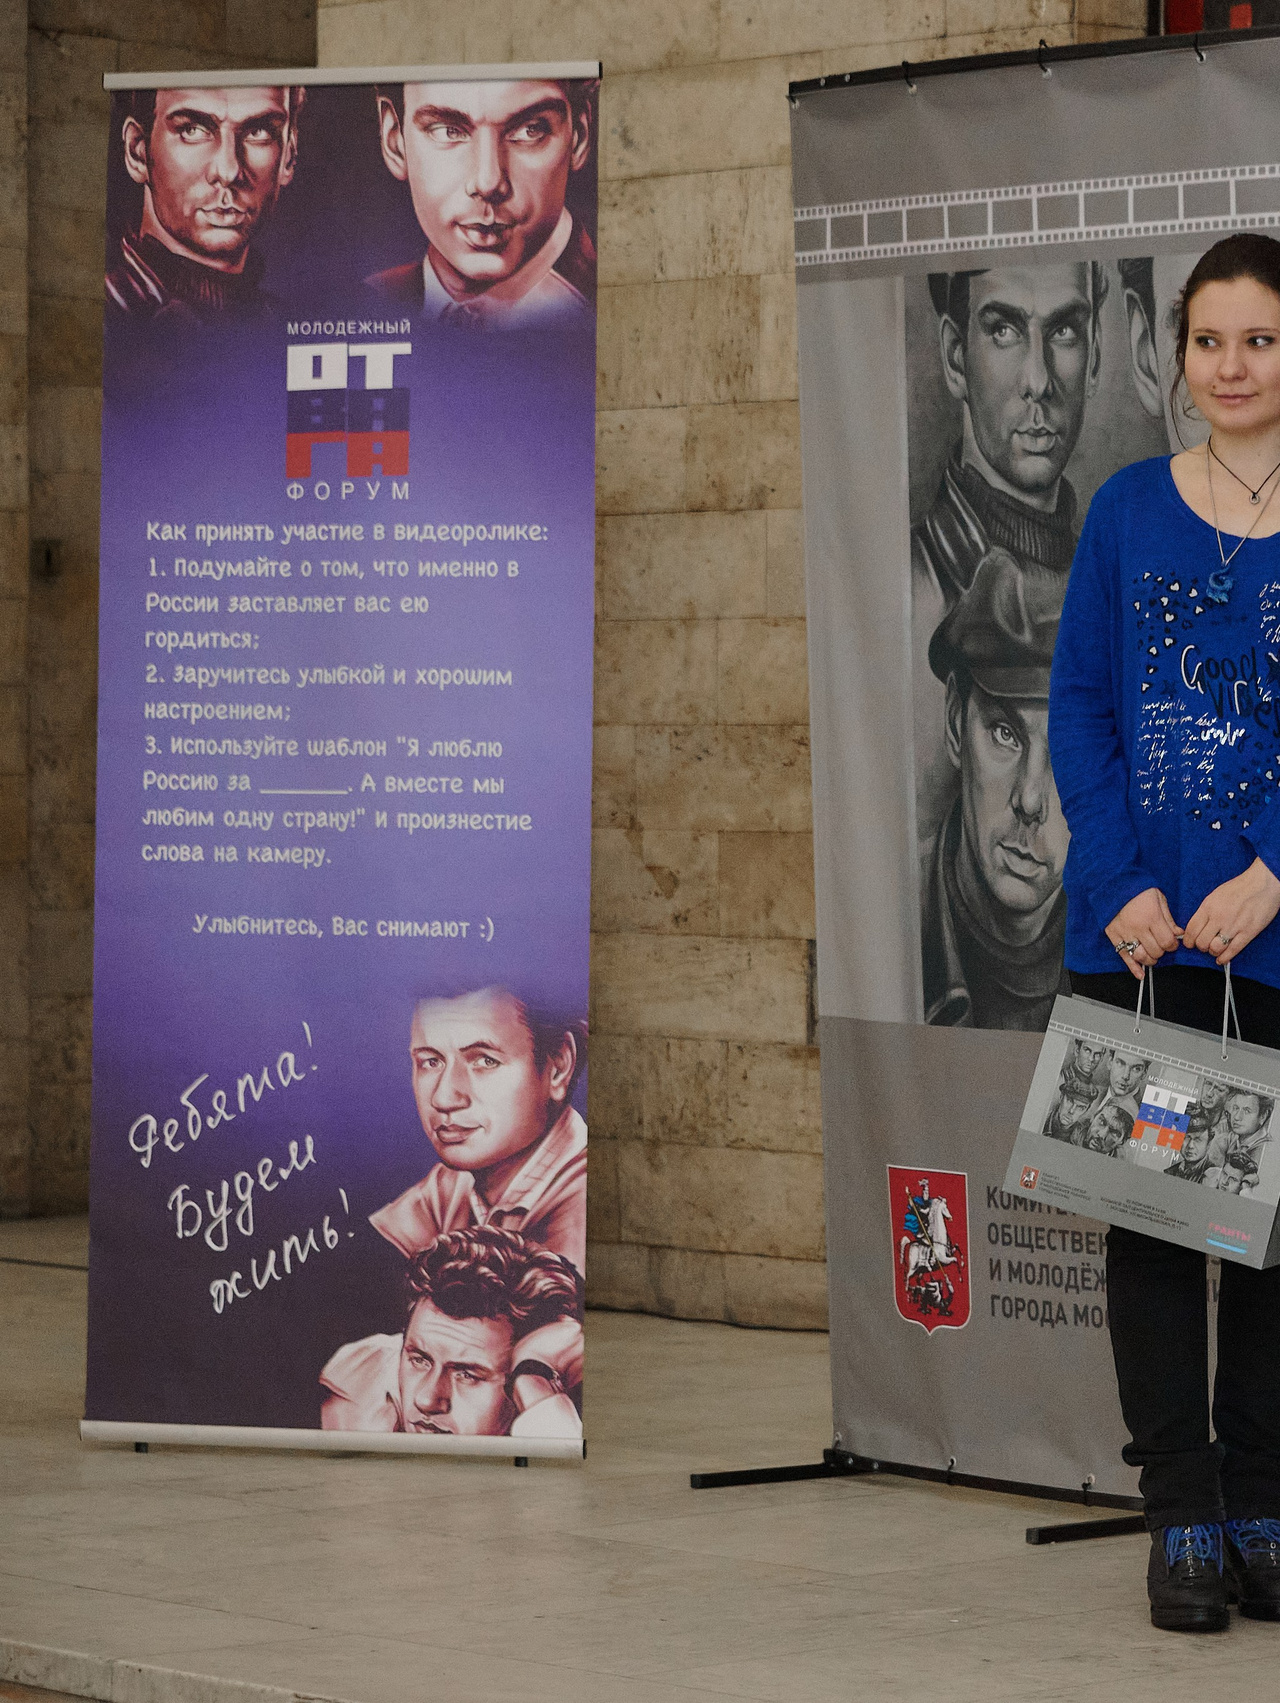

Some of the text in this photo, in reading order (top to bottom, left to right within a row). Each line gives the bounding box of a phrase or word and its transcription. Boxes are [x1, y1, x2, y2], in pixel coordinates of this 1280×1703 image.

[287, 319, 411, 335] МОЛОДЕЖНЫЙ
[287, 343, 412, 391] ОТ
[285, 431, 409, 478] ГА
[286, 481, 409, 501] ФОРУМ
[147, 522, 548, 546] Как принять участие в видеоролике:
[149, 556, 519, 582] 1. Подумайте о том, что именно в
[146, 593, 429, 614] России заставляет вас ею
[145, 631, 260, 653] гордиться;
[146, 664, 512, 690] 2. Заручитесь улыбкой и хорошим
[145, 702, 291, 724] настроением;
[145, 736, 502, 759] 3. Используйте шаблон "Я люблю
[143, 772, 218, 791] Россию
[227, 773, 250, 791] за
[361, 774, 375, 793] А
[385, 775, 463, 794] вместе
[474, 776, 504, 794] мы
[142, 809, 213, 827] любим
[224, 810, 274, 832] одну
[283, 808, 365, 832] страну!"
[398, 811, 532, 835] произнестие
[142, 844, 331, 869] слова на камеру.
[193, 915, 323, 939] Улыбнитесь,
[332, 917, 368, 937] Вас
[377, 918, 469, 939] снимают
[129, 1021, 318, 1167] Ребята!
[1148, 1075, 1199, 1094] МОЛОДЕЖНЫЙ
[1130, 1140, 1179, 1160] ФОРУМ
[168, 1134, 315, 1251] Будем
[210, 1188, 354, 1313] жить!
[990, 1258, 1106, 1294] И МОЛОДЁЖ
[991, 1295, 1068, 1328] ГОРОДА
